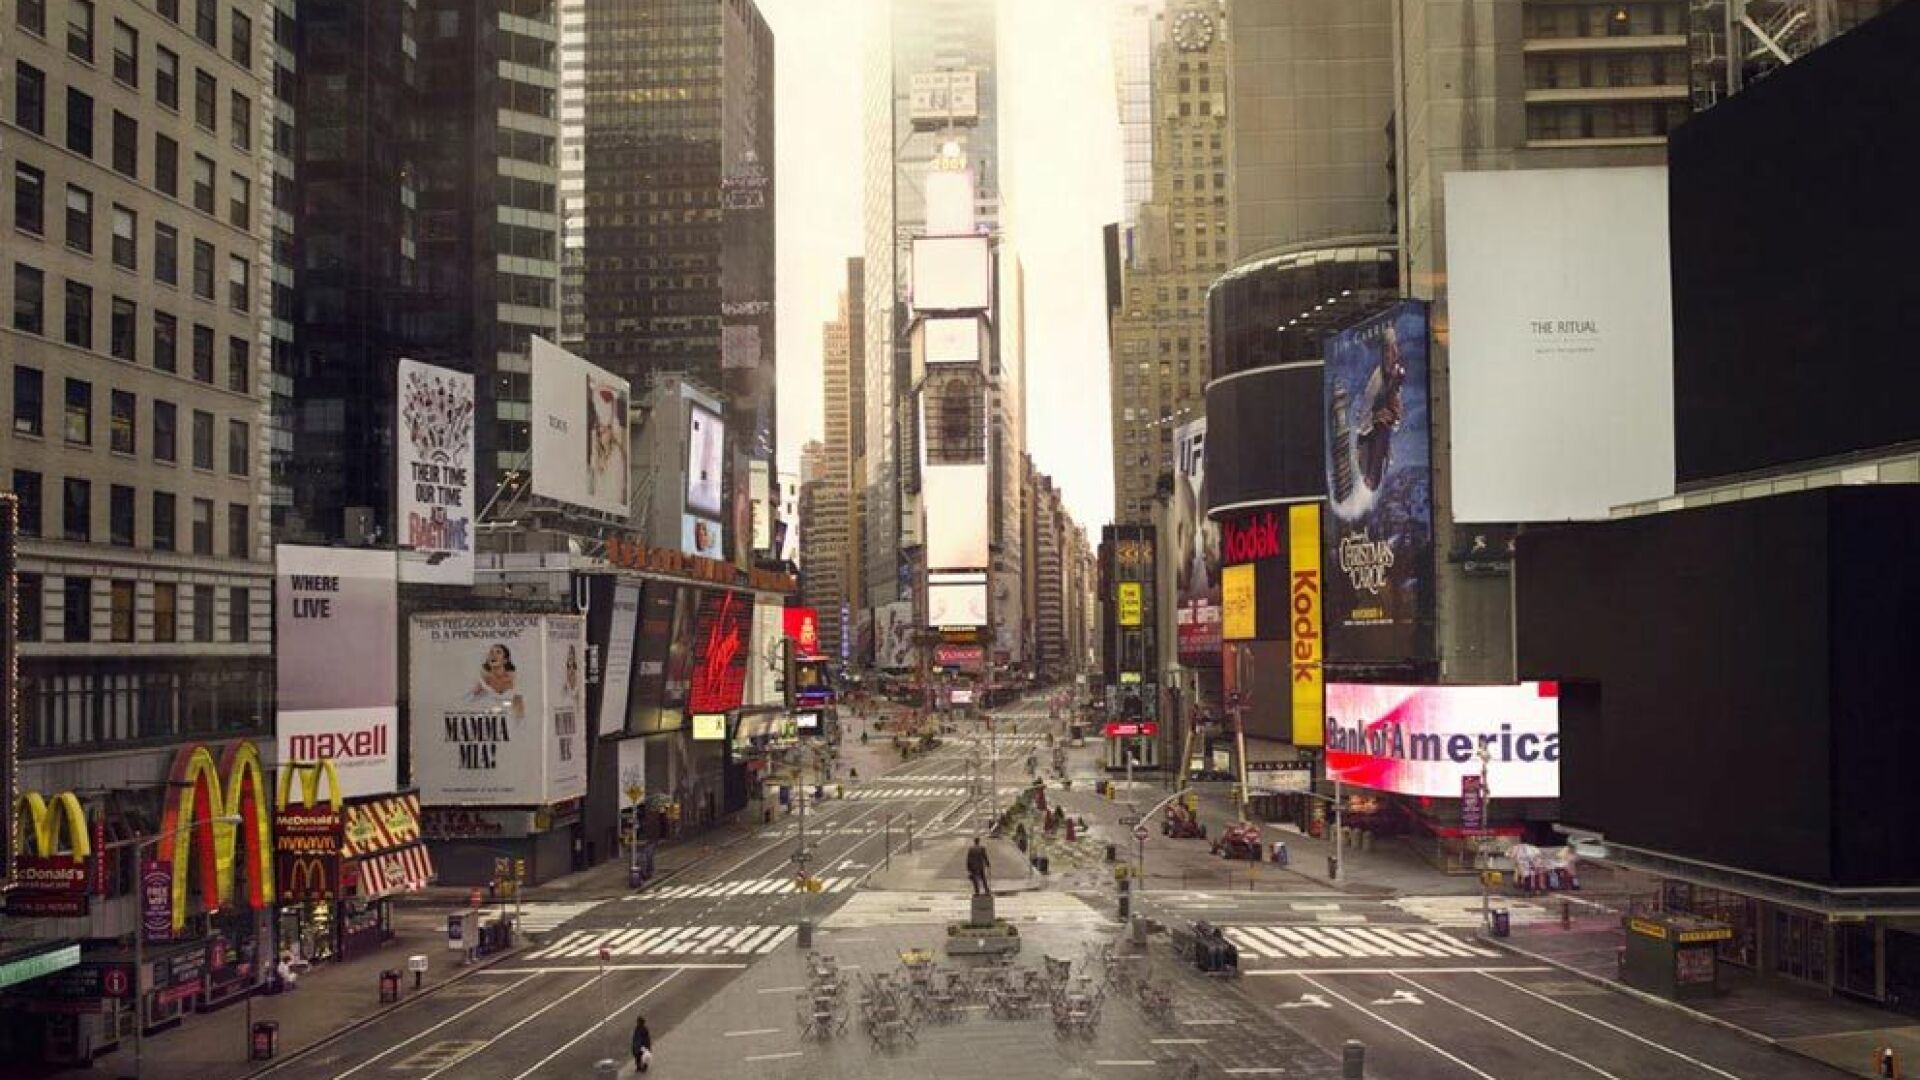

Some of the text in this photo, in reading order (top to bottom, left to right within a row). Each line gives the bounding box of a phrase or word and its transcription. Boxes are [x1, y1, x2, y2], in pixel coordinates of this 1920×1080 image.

[1530, 320, 1597, 333] THE RITUAL
[411, 462, 467, 487] THEIR TIME
[416, 484, 462, 507] OUR TIME
[1225, 514, 1280, 563] Kodak
[291, 574, 340, 593] WHERE
[293, 597, 331, 619] LIVE
[1294, 570, 1319, 682] Kodak
[445, 716, 510, 742] MAMMA
[1328, 717, 1368, 754] Bank
[1372, 722, 1389, 756] of
[289, 724, 387, 761] maxell
[459, 744, 497, 769] MIA!
[277, 816, 340, 827] McDonald's
